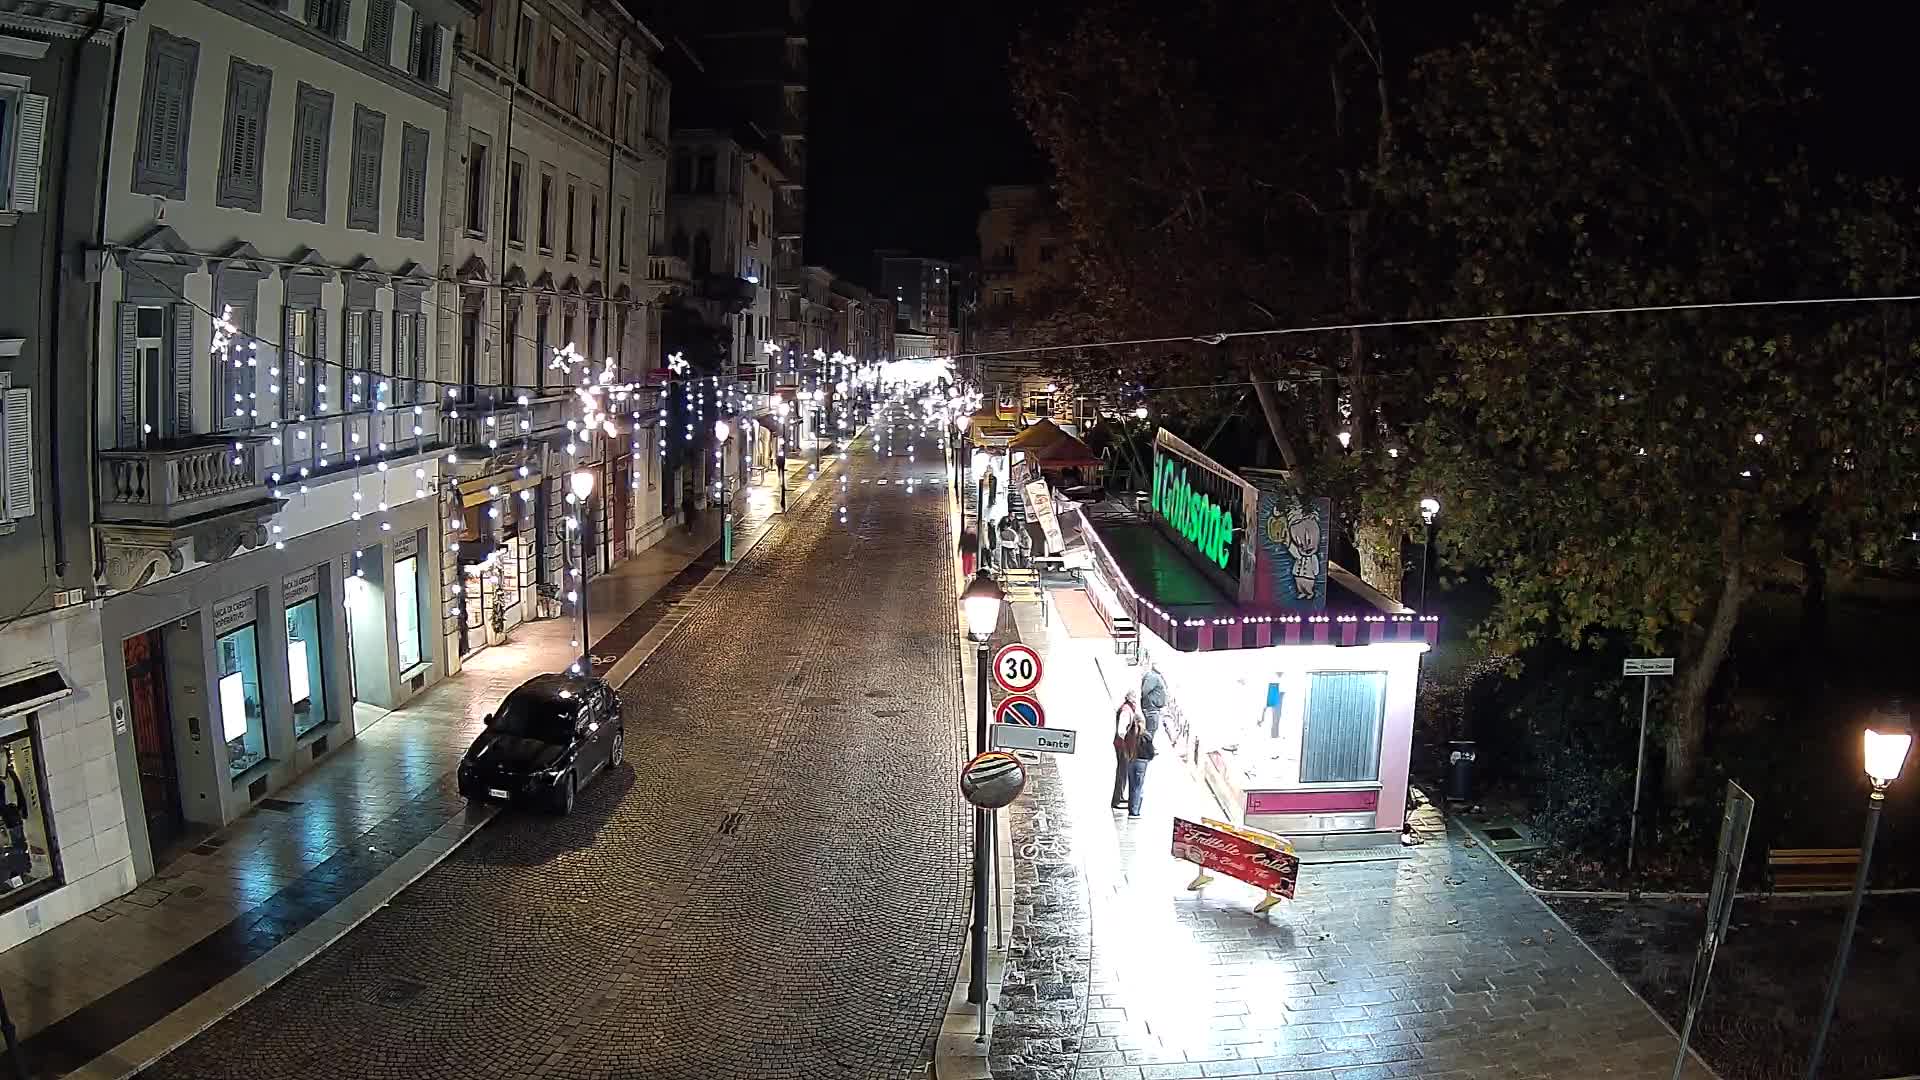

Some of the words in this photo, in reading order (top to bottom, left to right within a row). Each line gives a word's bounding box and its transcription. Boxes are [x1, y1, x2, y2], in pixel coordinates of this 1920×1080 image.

[1162, 459, 1233, 569] Golosone
[1005, 658, 1033, 680] 30
[1038, 737, 1070, 749] Dante
[1243, 853, 1292, 874] Calde
